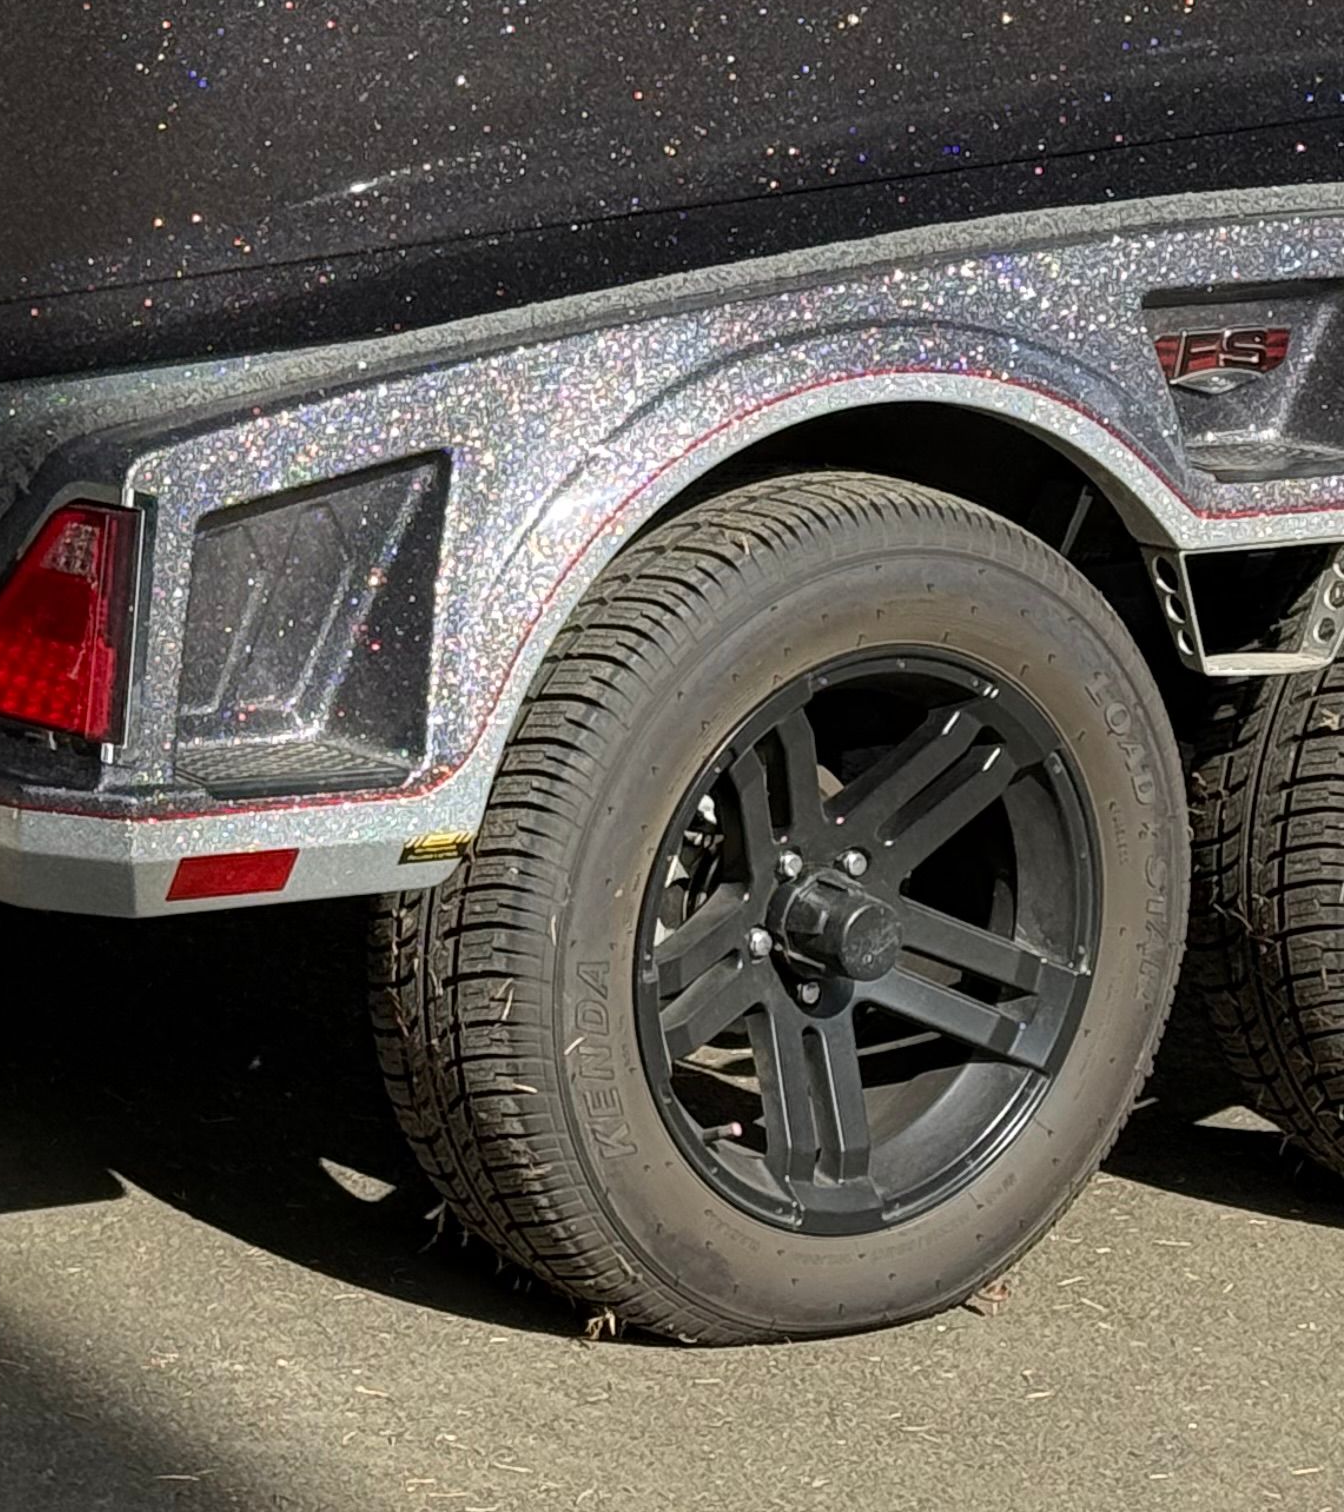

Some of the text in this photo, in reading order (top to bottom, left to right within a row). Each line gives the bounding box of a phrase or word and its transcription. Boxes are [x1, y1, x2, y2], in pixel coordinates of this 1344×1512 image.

[1174, 326, 1267, 378] FS
[1084, 672, 1157, 806] LOAD
[575, 960, 638, 1160] KENDA
